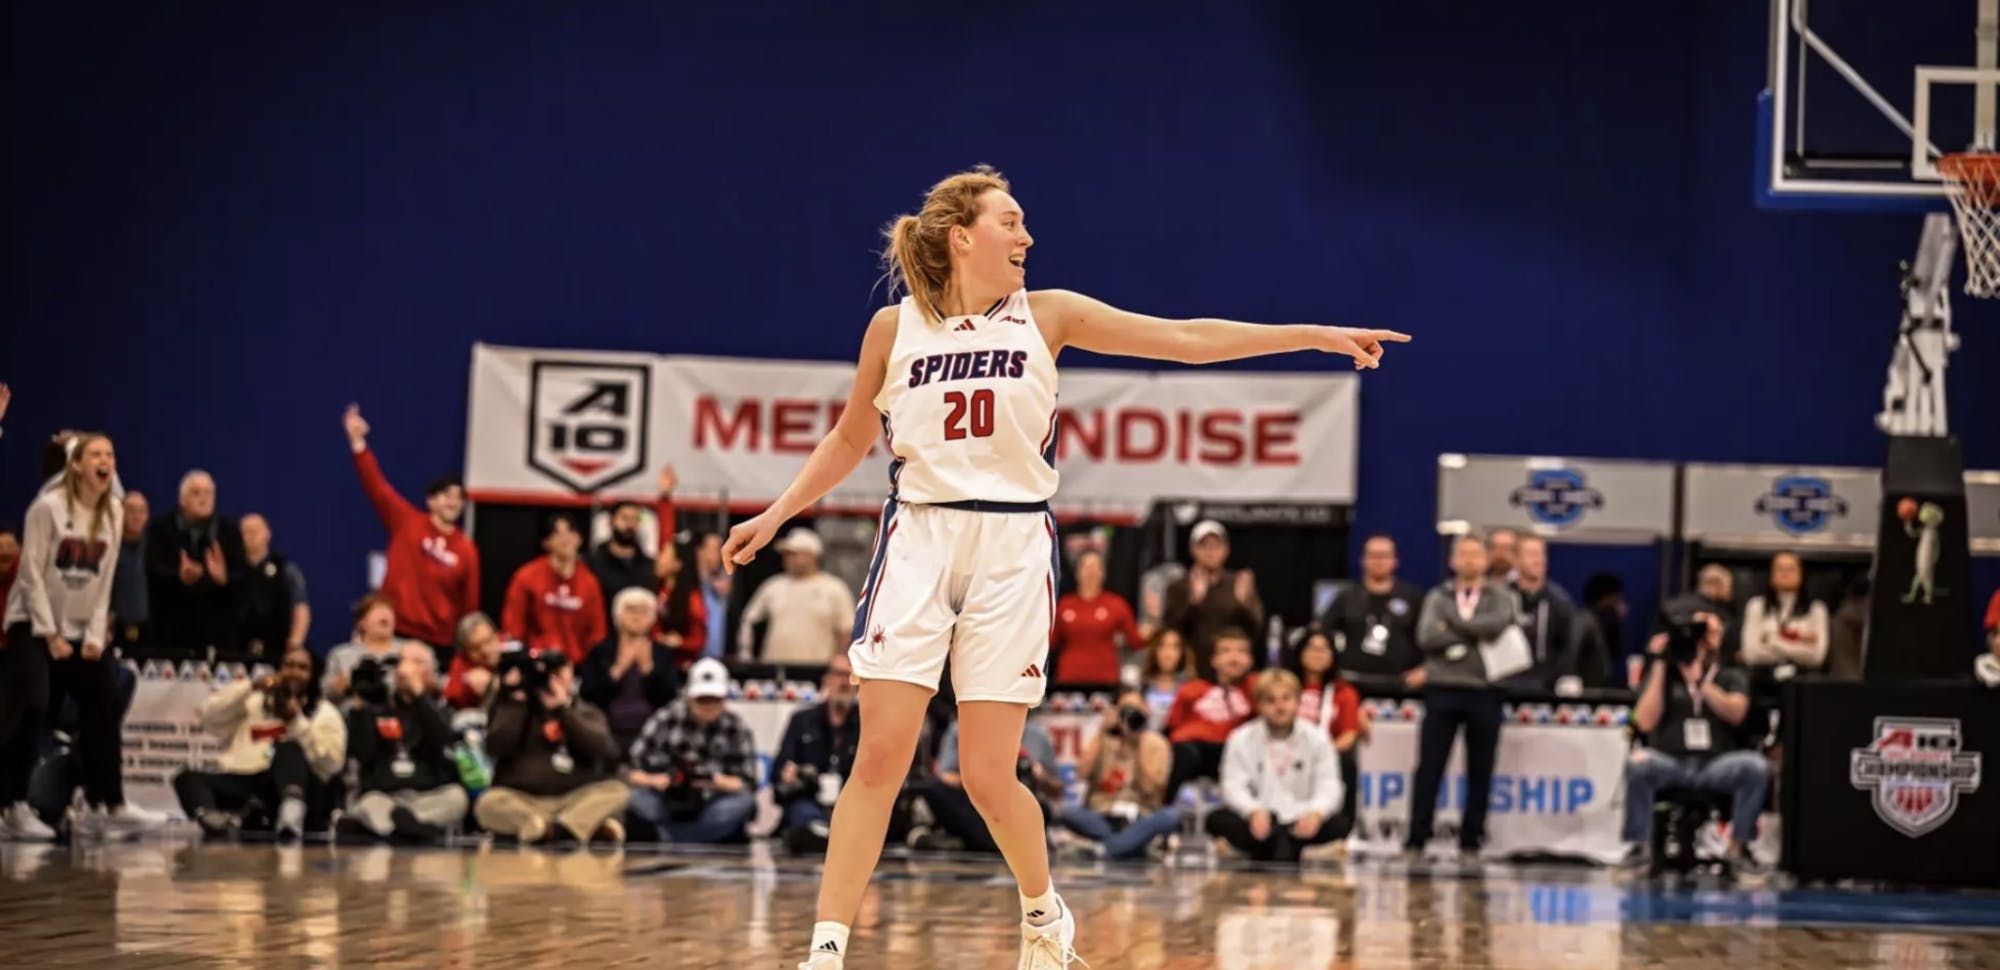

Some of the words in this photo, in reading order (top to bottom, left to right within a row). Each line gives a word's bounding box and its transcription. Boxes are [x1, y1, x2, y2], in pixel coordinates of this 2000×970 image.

[908, 349, 1028, 389] SPIDERS
[562, 382, 628, 418] A
[944, 388, 995, 441] 20
[550, 423, 626, 452] 10
[692, 394, 1302, 467] MENDISE
